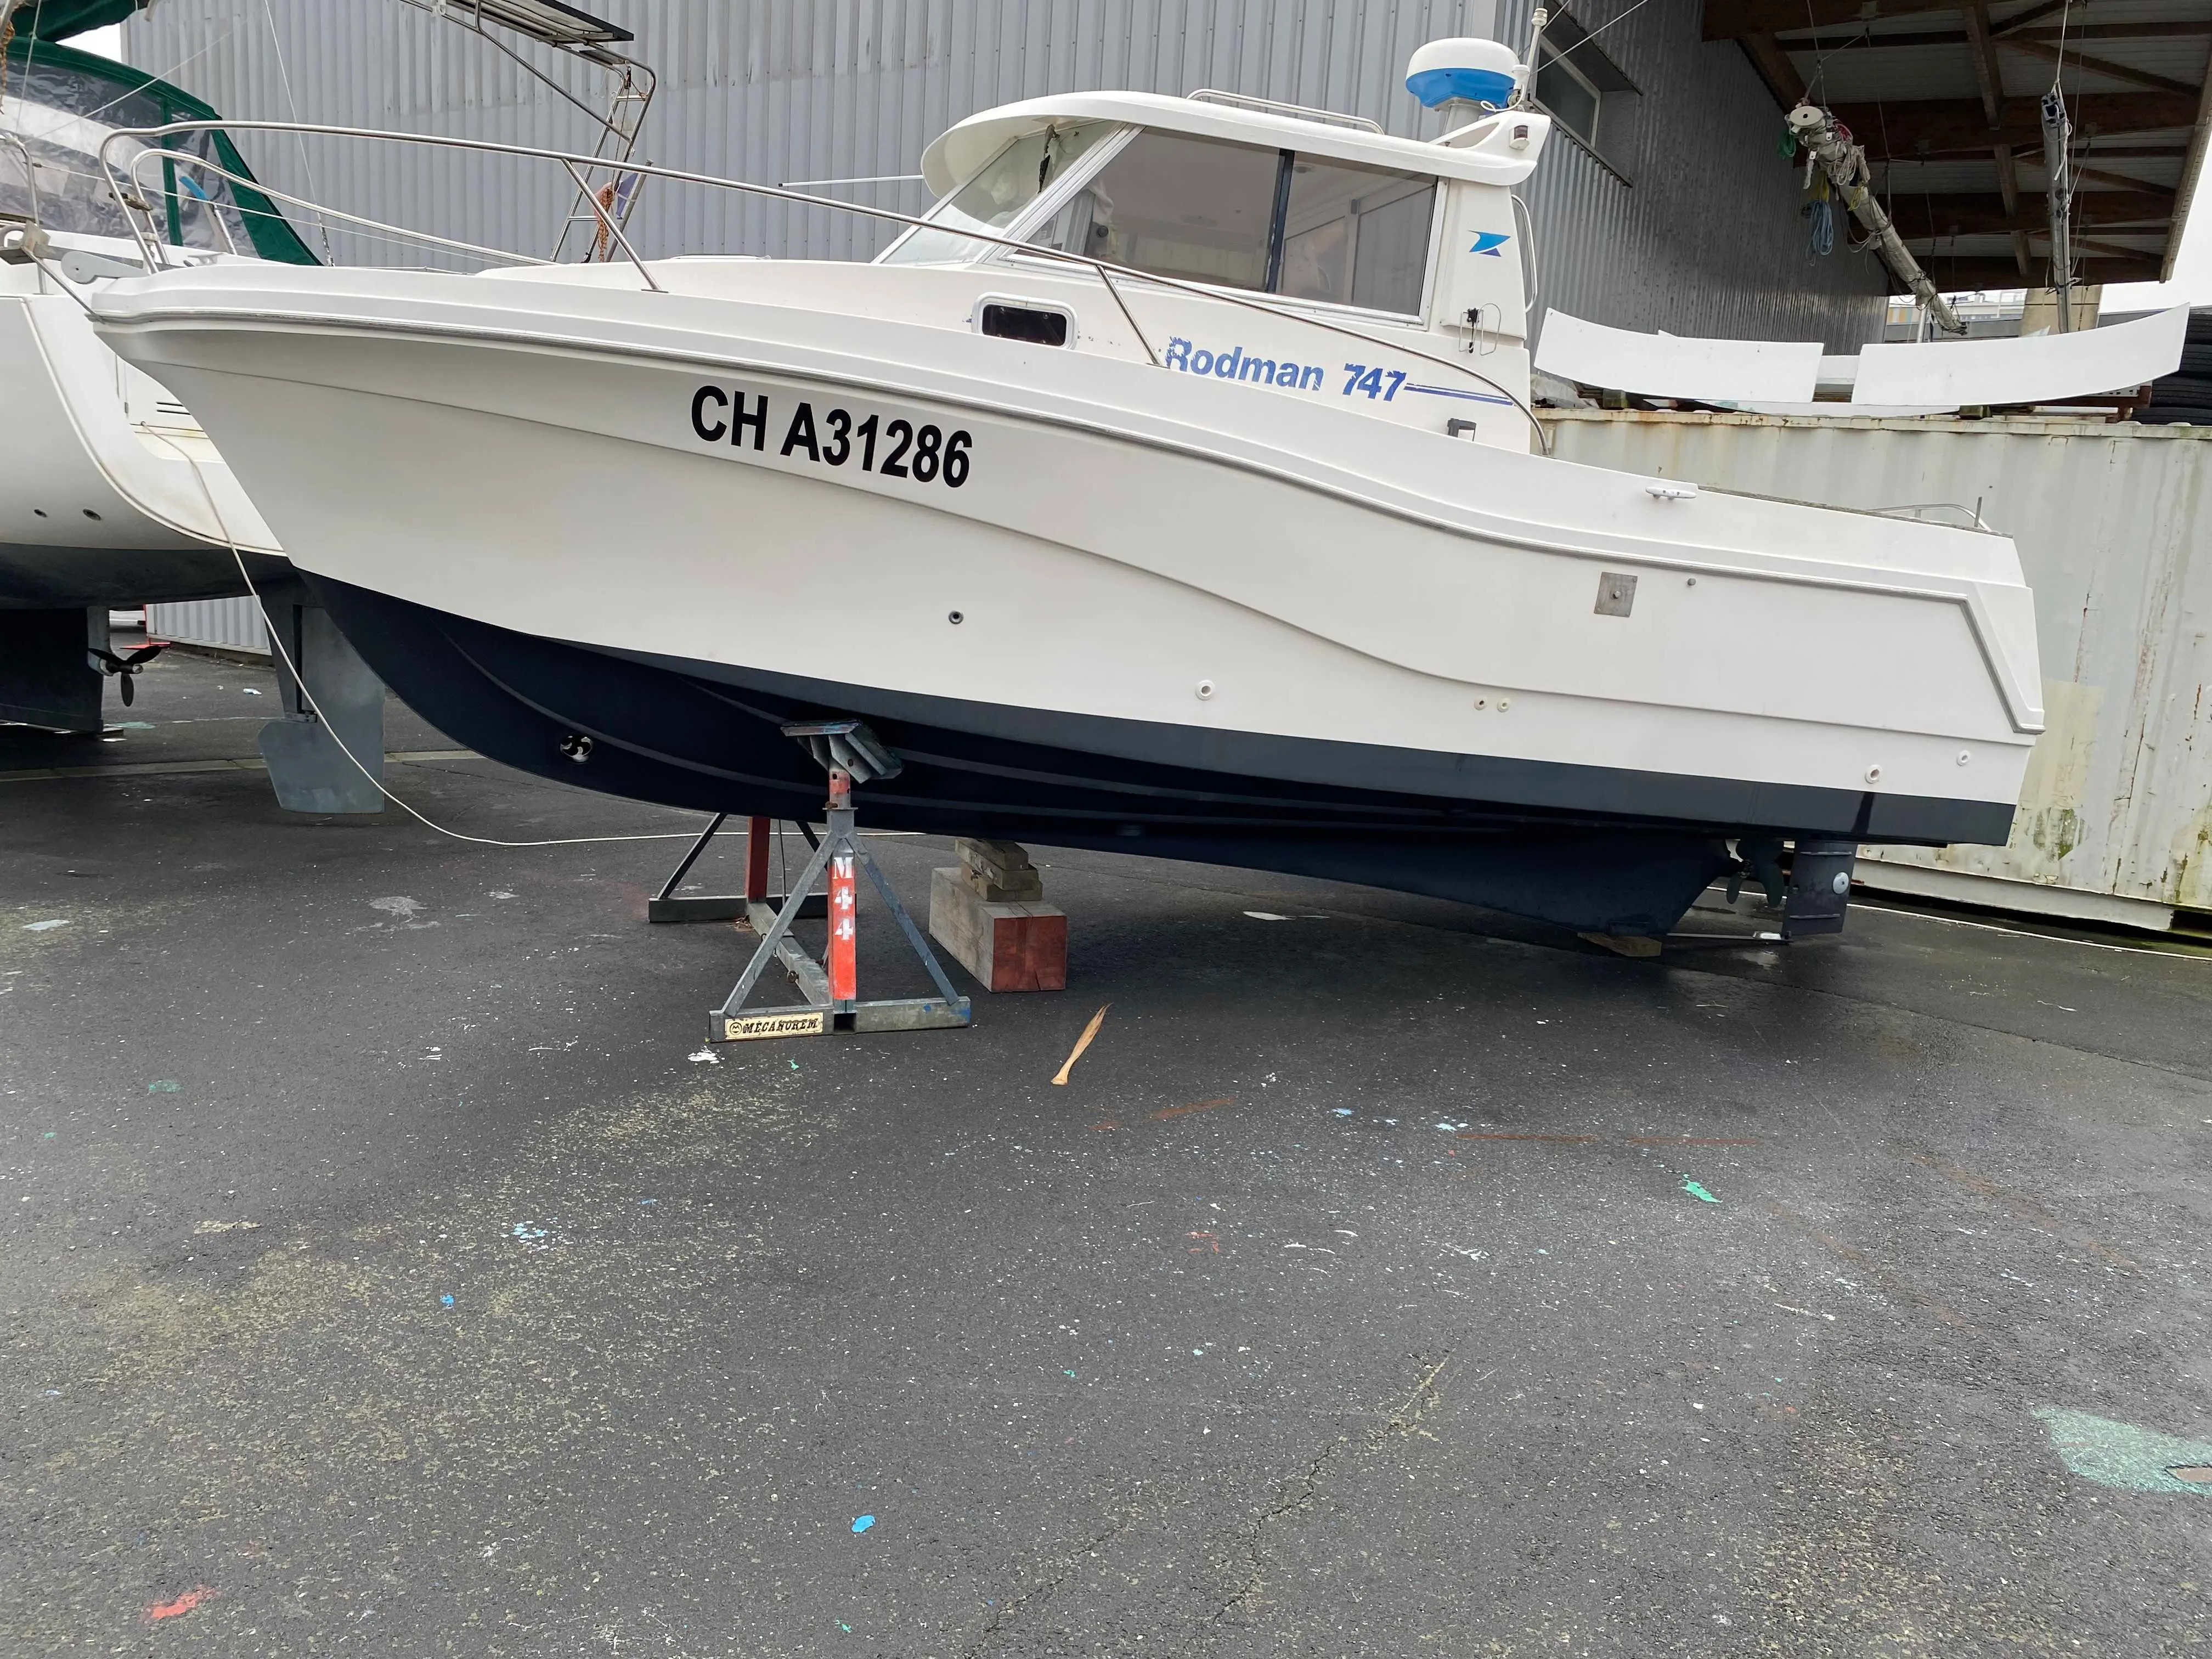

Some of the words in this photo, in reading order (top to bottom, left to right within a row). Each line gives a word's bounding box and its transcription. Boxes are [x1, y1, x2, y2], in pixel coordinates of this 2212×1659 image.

[1165, 336, 1324, 391] Rodman
[1342, 363, 1407, 402] 747
[691, 385, 769, 452] CH
[780, 402, 972, 488] A31286
